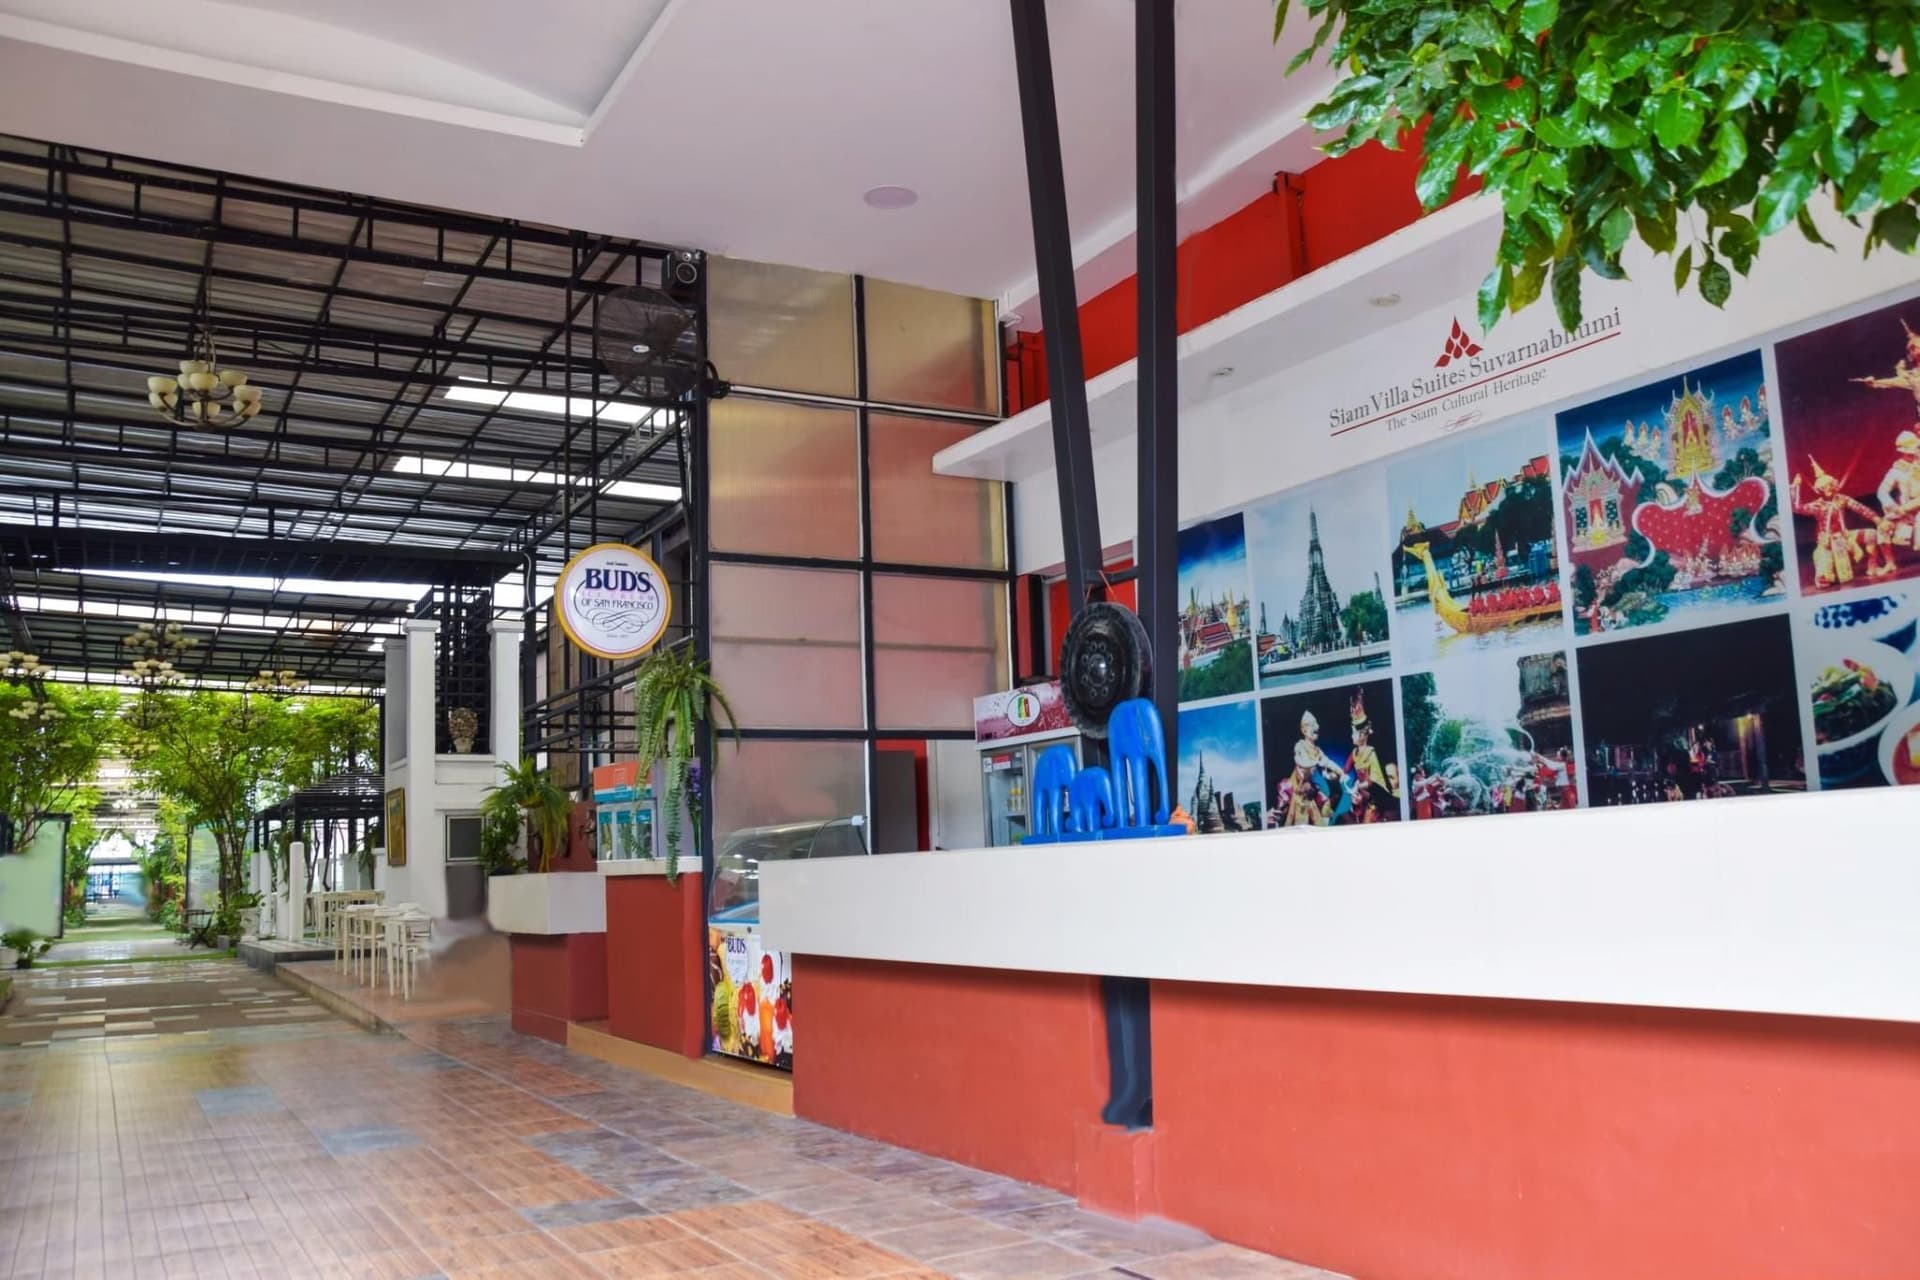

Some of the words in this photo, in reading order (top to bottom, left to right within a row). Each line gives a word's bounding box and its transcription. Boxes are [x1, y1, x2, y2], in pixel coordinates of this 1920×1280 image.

[1329, 404, 1370, 428] Siam
[1371, 384, 1409, 412] Villa
[1413, 367, 1466, 398] Suites
[1387, 416, 1408, 432] The
[1410, 407, 1438, 424] Siam
[1442, 387, 1489, 411] Cultural
[1493, 368, 1547, 396] Heritage
[581, 599, 591, 607] OF
[594, 599, 610, 608] SAN
[612, 600, 653, 609] FRANCISCO
